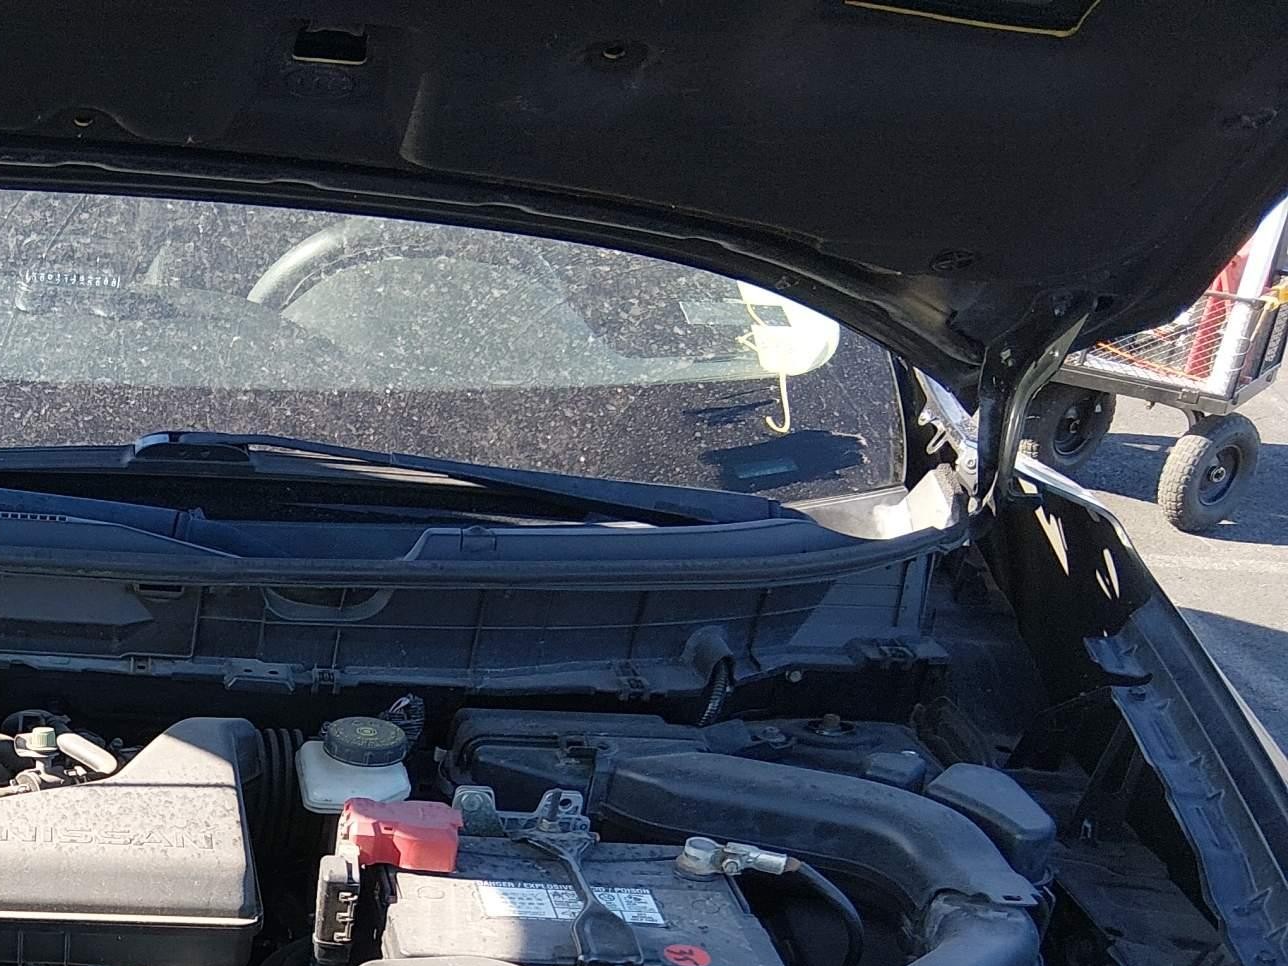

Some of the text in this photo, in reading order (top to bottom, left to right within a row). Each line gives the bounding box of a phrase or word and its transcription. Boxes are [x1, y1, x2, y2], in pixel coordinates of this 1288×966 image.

[0, 826, 215, 850] NISSAN
[477, 880, 515, 888] DANGER
[523, 882, 574, 890] EXPLOSIVE
